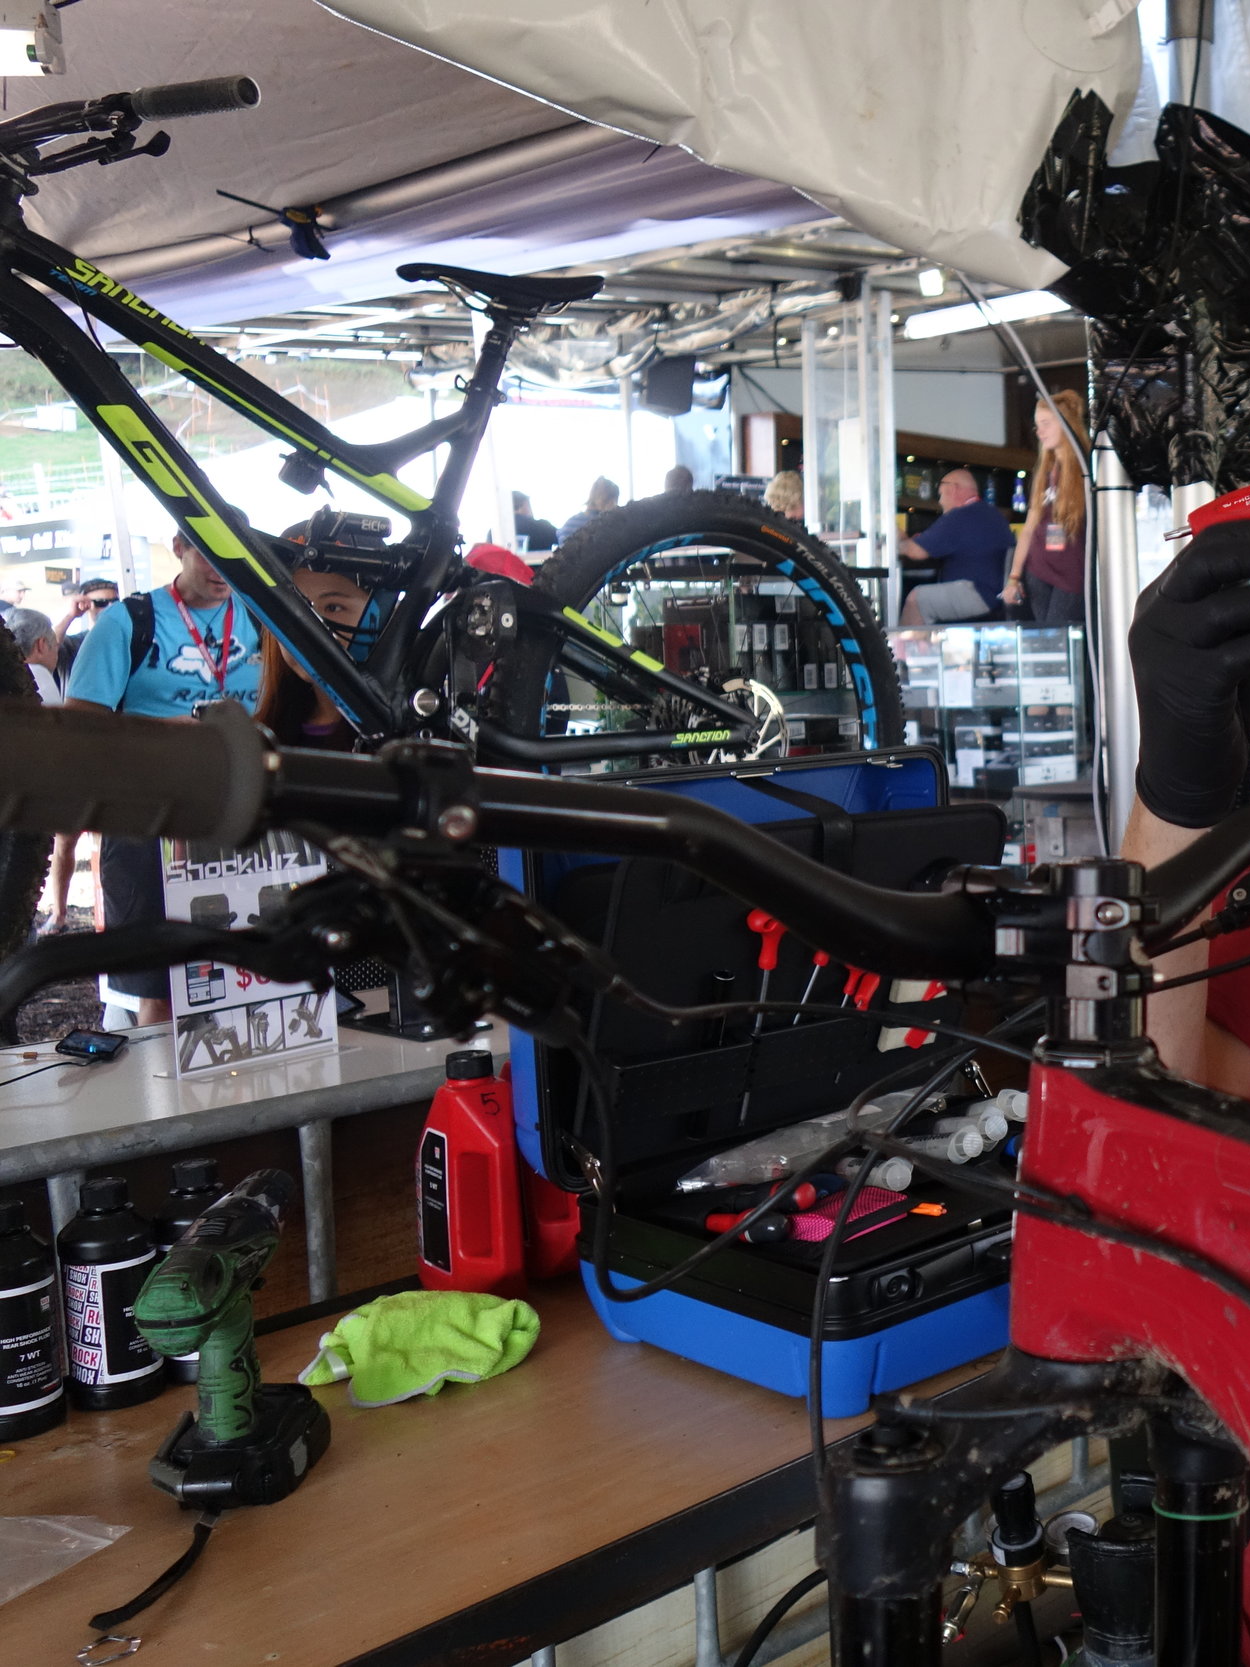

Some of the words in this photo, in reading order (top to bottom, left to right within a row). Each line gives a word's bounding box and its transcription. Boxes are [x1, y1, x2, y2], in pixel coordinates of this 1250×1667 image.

[96, 404, 277, 587] GT
[671, 730, 730, 745] SANCTION
[480, 1092, 501, 1116] 5
[20, 1354, 26, 1362] 7
[27, 1349, 41, 1361] WT
[71, 1344, 98, 1367] ROCK
[71, 1363, 97, 1385] SHOX
